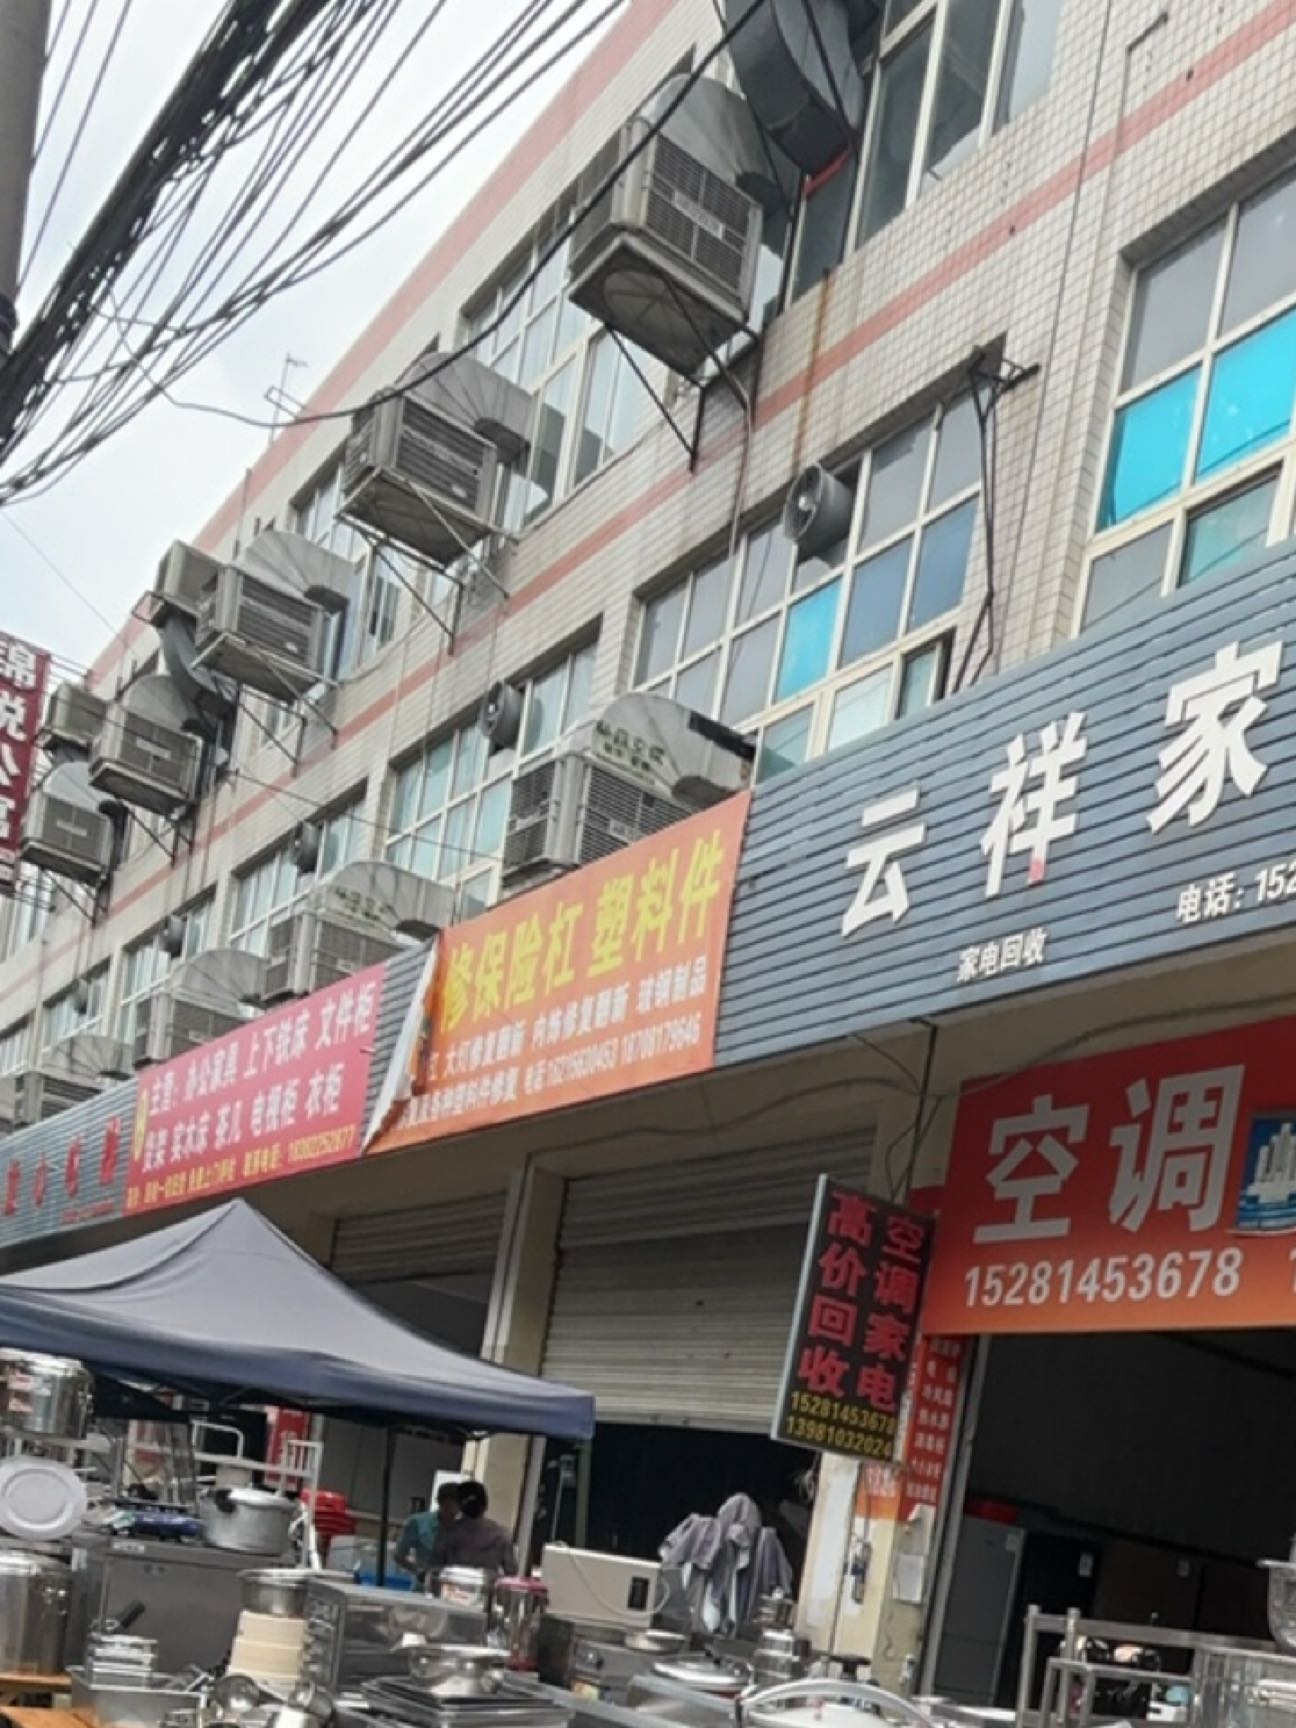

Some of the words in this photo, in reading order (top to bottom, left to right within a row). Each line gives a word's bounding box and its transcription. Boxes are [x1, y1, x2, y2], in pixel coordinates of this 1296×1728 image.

[956, 928, 1048, 984] 家电回收
[972, 1063, 1245, 1245] 空调
[798, 1190, 878, 1398] 高价回收
[964, 1246, 1244, 1308] 15281453678
[856, 1213, 927, 1413] 空调家电
[786, 1415, 894, 1457] 13981032024
[791, 1390, 898, 1435] 15281453678
